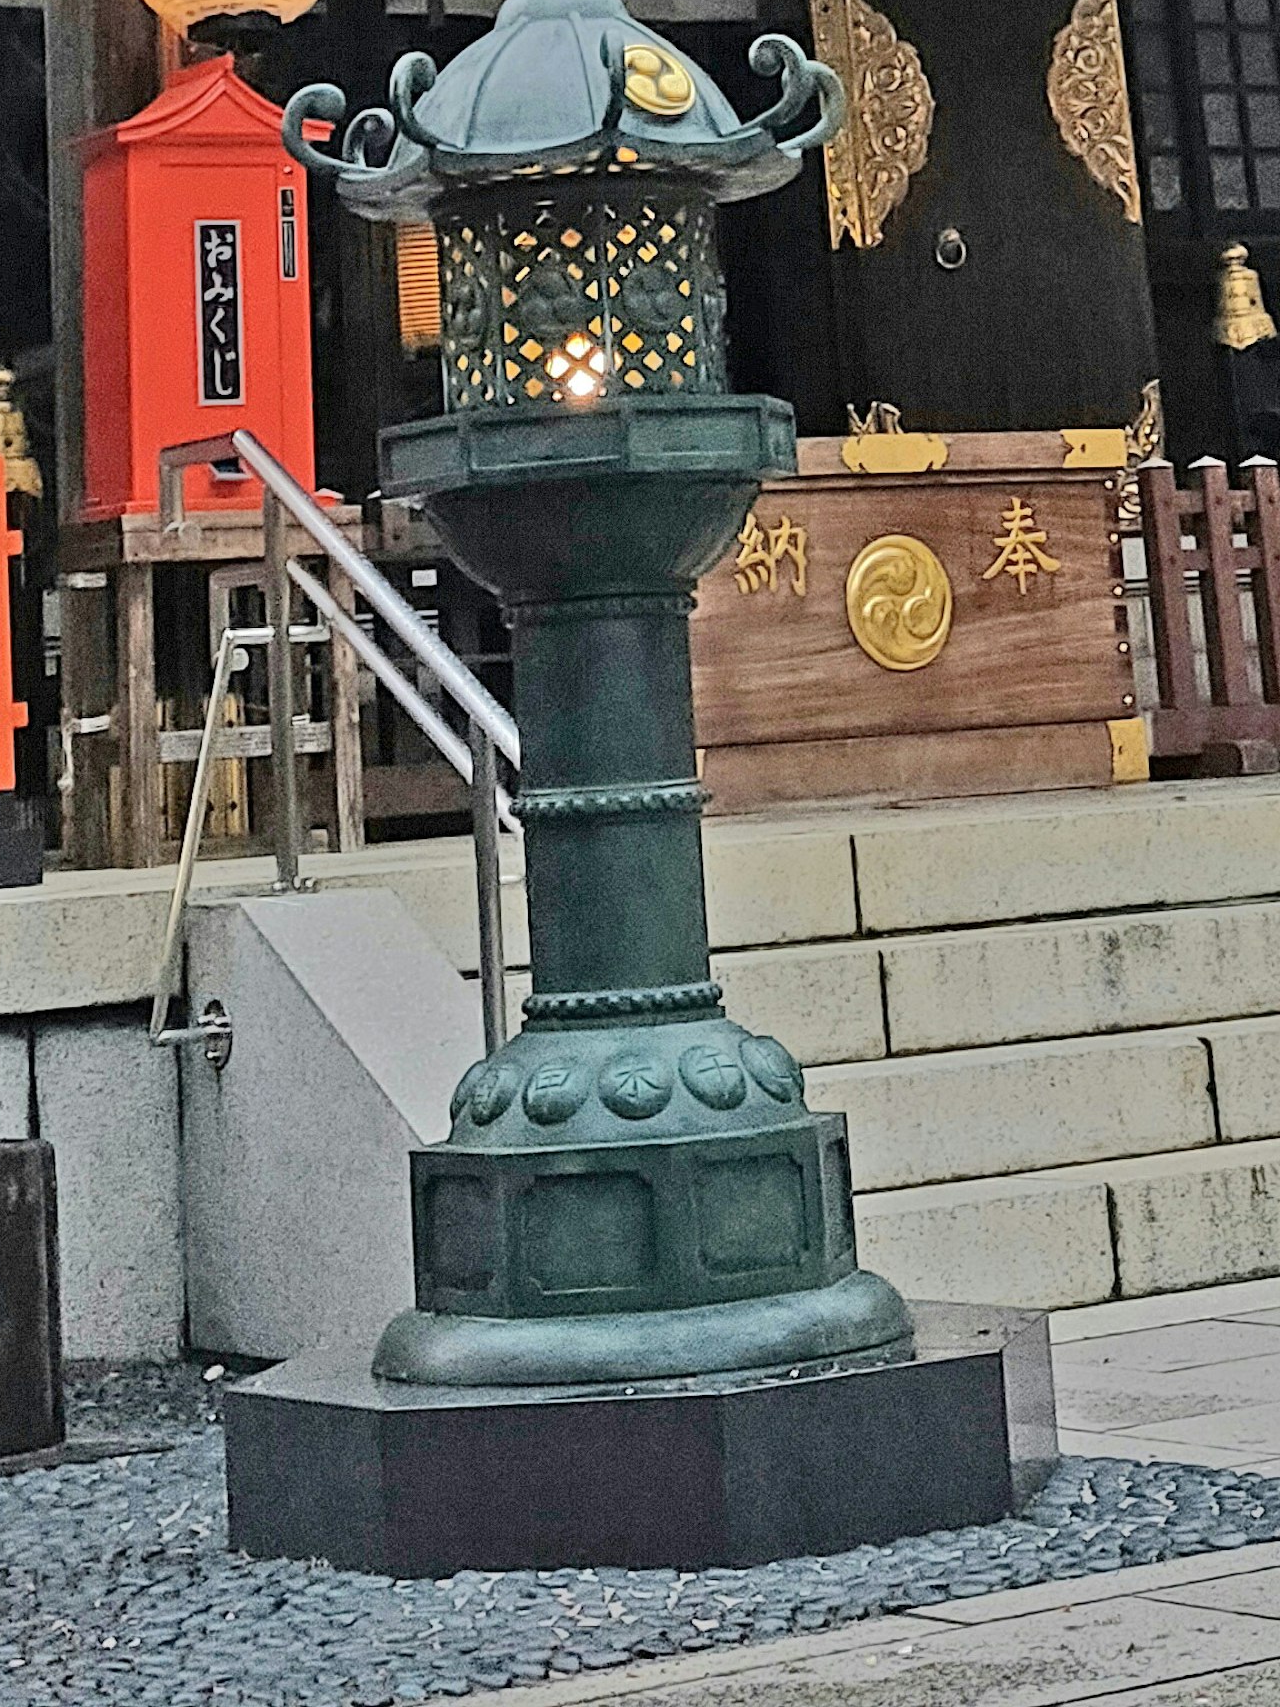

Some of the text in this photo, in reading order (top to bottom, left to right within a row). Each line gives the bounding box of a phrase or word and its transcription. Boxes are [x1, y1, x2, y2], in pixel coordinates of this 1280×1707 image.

[204, 228, 237, 397] おみくじ
[734, 497, 1061, 597] 奉 納
